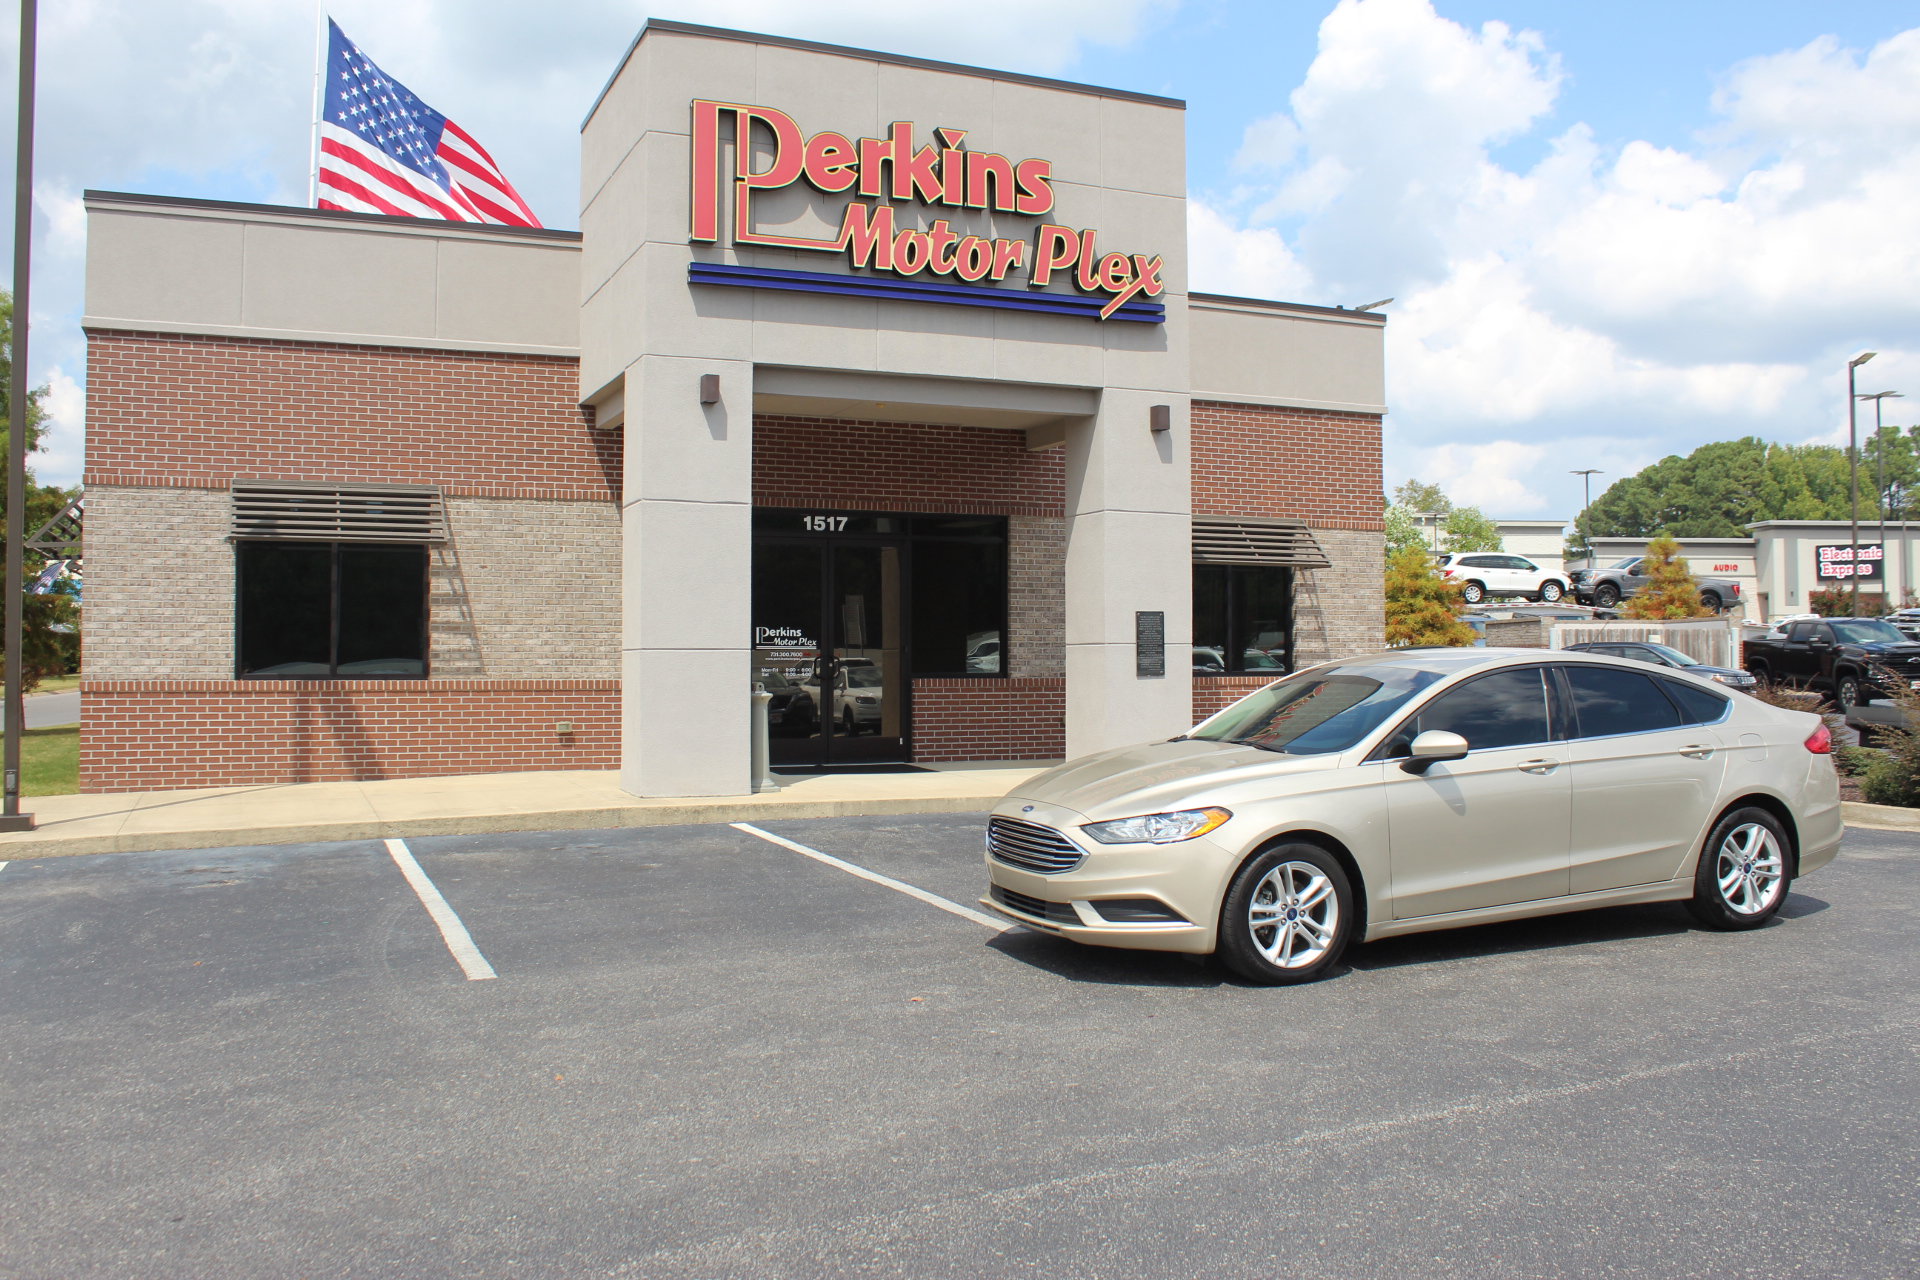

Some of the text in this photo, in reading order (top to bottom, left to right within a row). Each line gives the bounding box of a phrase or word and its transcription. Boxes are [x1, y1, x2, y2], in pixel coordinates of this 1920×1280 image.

[690, 98, 1054, 242] Perkins
[838, 202, 1165, 320] Motor Plex
[803, 515, 849, 532] 1517
[1713, 564, 1739, 572] AUDIO
[1821, 563, 1873, 578] Exprss
[756, 627, 802, 643] Perkins
[773, 637, 817, 648] Motor Plex
